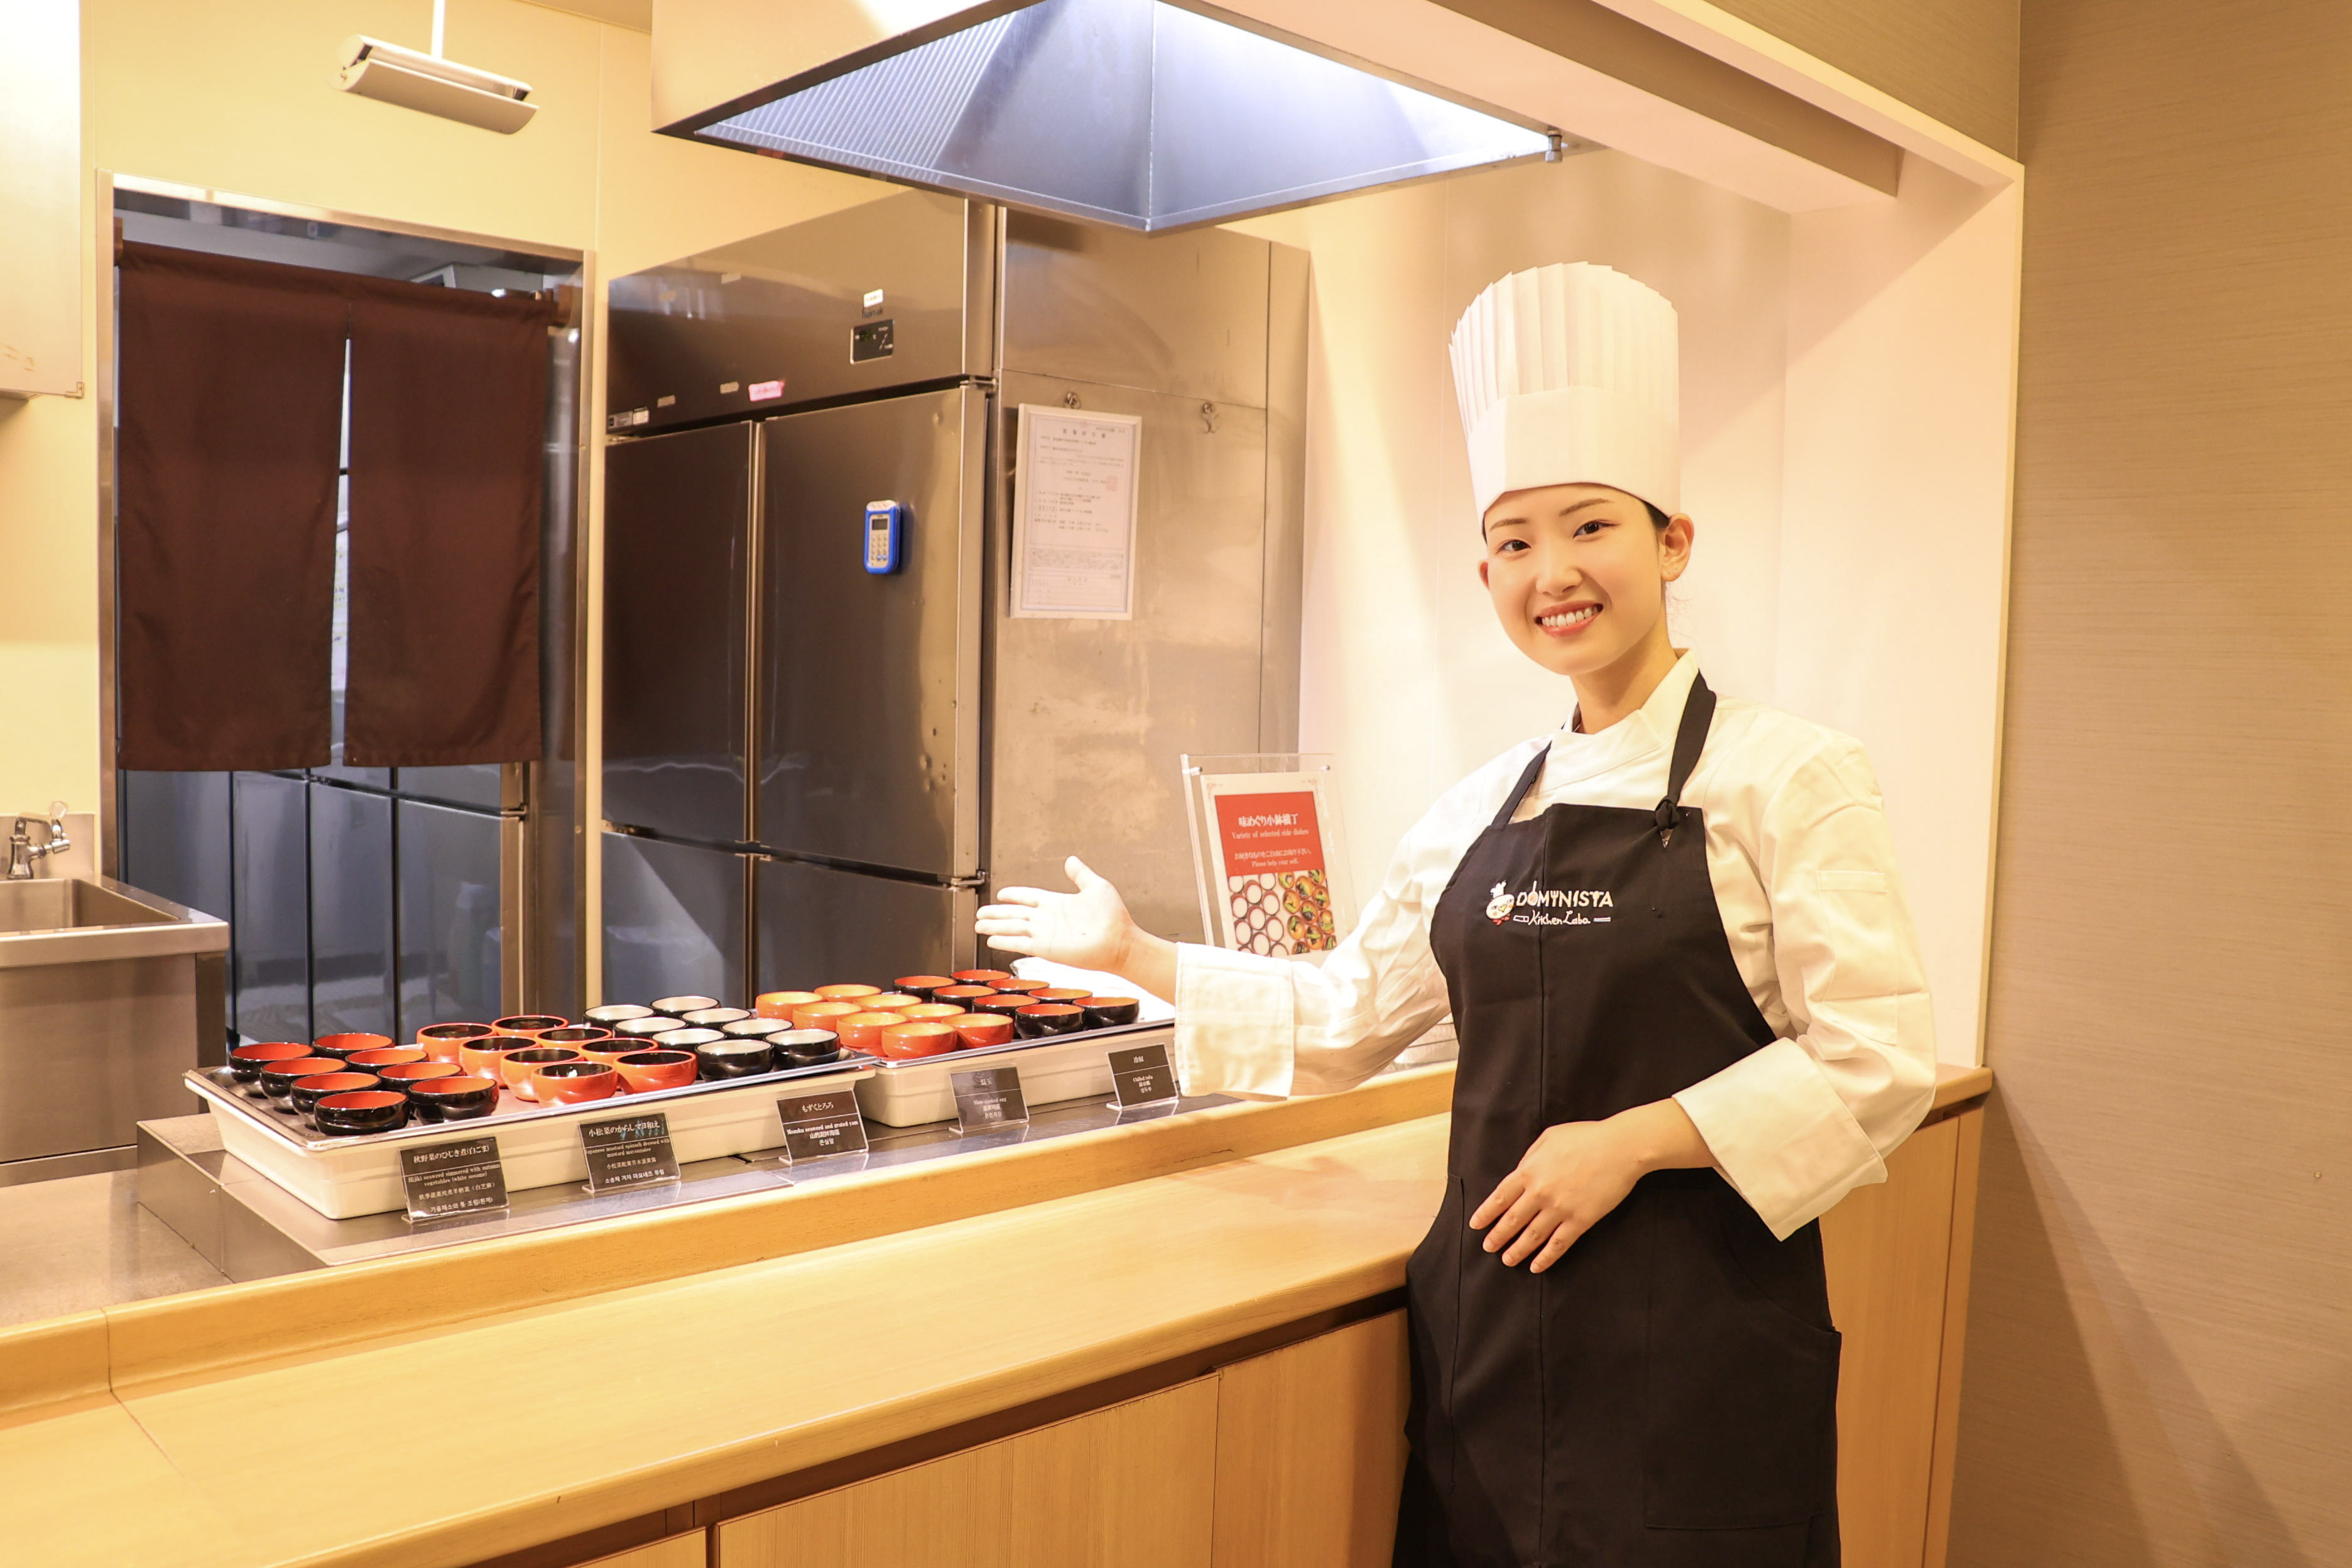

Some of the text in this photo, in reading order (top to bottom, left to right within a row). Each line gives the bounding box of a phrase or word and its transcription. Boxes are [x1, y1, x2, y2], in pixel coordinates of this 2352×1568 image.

[1260, 829, 1280, 837] selected
[1293, 827, 1309, 836] dishes
[1516, 881, 1614, 907] DOMINISTA
[1527, 909, 1563, 925] Kitchen
[802, 1102, 834, 1113] もずくとろろ
[589, 1120, 660, 1137] 小松菜のからしマヨ和え
[413, 1145, 489, 1163] 秋野菜のひじき煮(白ごま)
[423, 1172, 444, 1180] seaweed
[445, 1168, 469, 1177] simmered
[424, 1179, 450, 1187] vegetables
